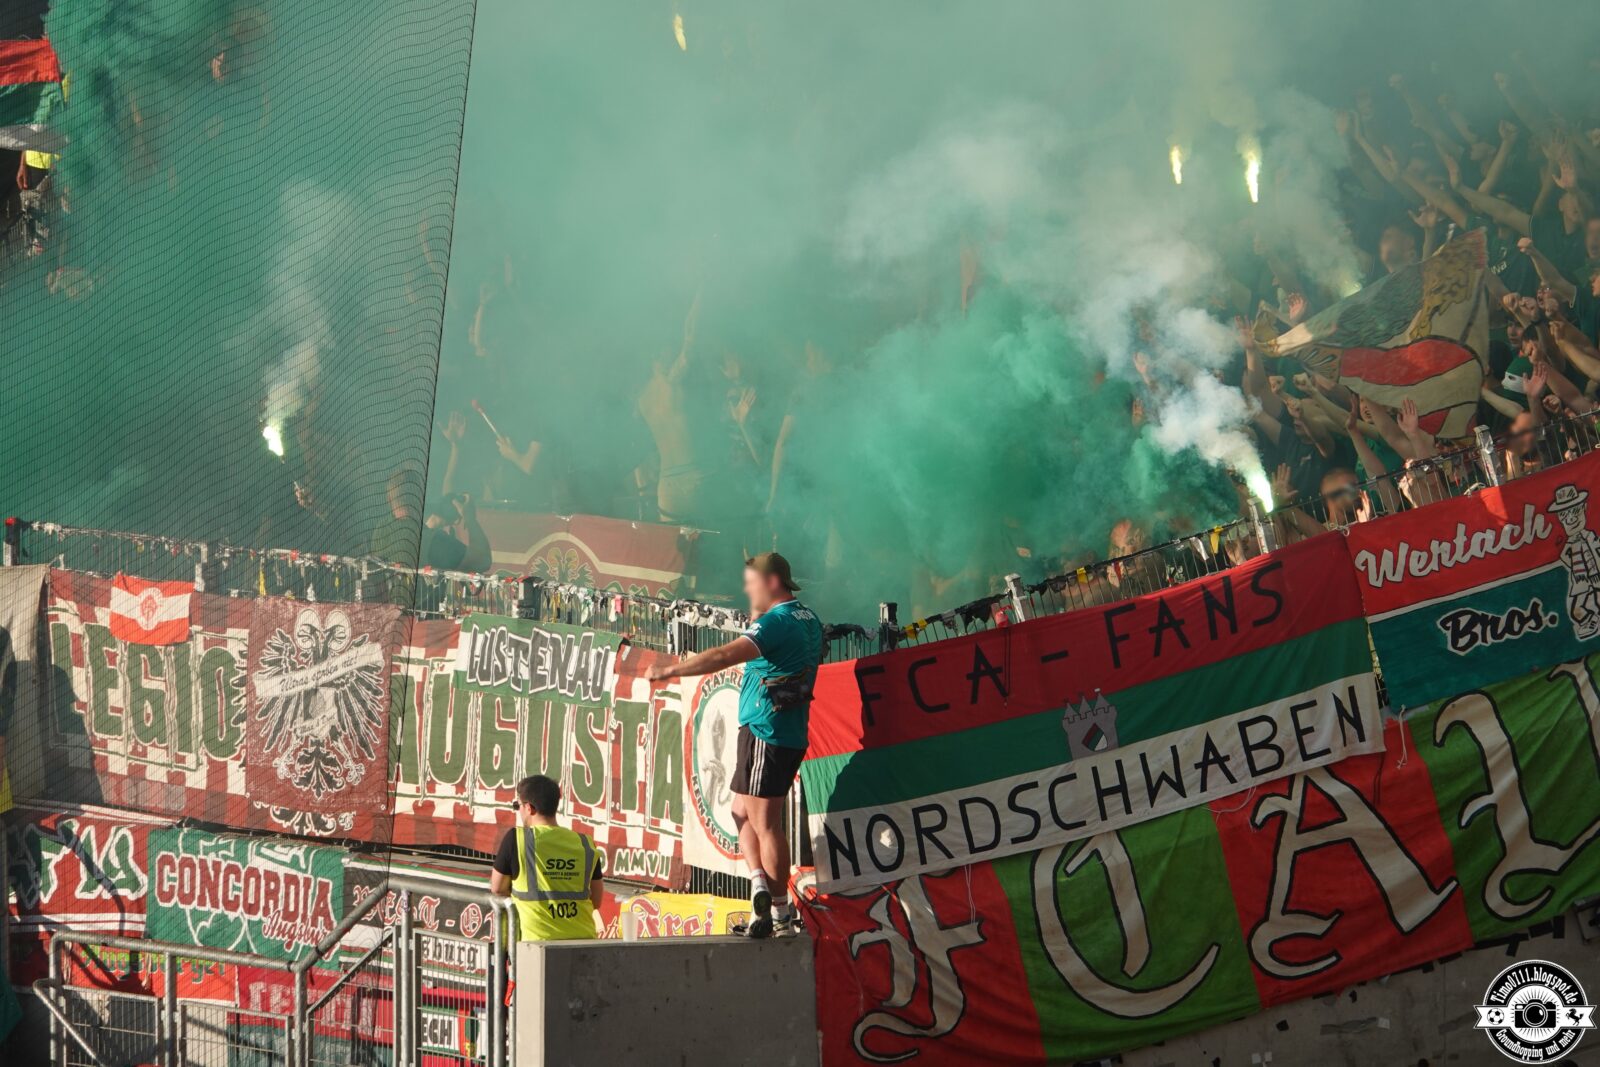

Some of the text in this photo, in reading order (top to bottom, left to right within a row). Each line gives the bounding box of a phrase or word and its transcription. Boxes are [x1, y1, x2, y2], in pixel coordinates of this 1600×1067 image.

[1355, 503, 1552, 588] Wertach
[466, 623, 612, 701] LUSTENAU
[855, 643, 1004, 727] FCA
[1102, 560, 1285, 669] FANS
[1437, 598, 1559, 656] Bros.
[701, 671, 726, 698] STAY
[823, 684, 1367, 881] NORDSCHWABEN
[155, 851, 337, 931] CONCORDIA
[546, 859, 576, 870] SDS
[614, 847, 672, 881] MMVII
